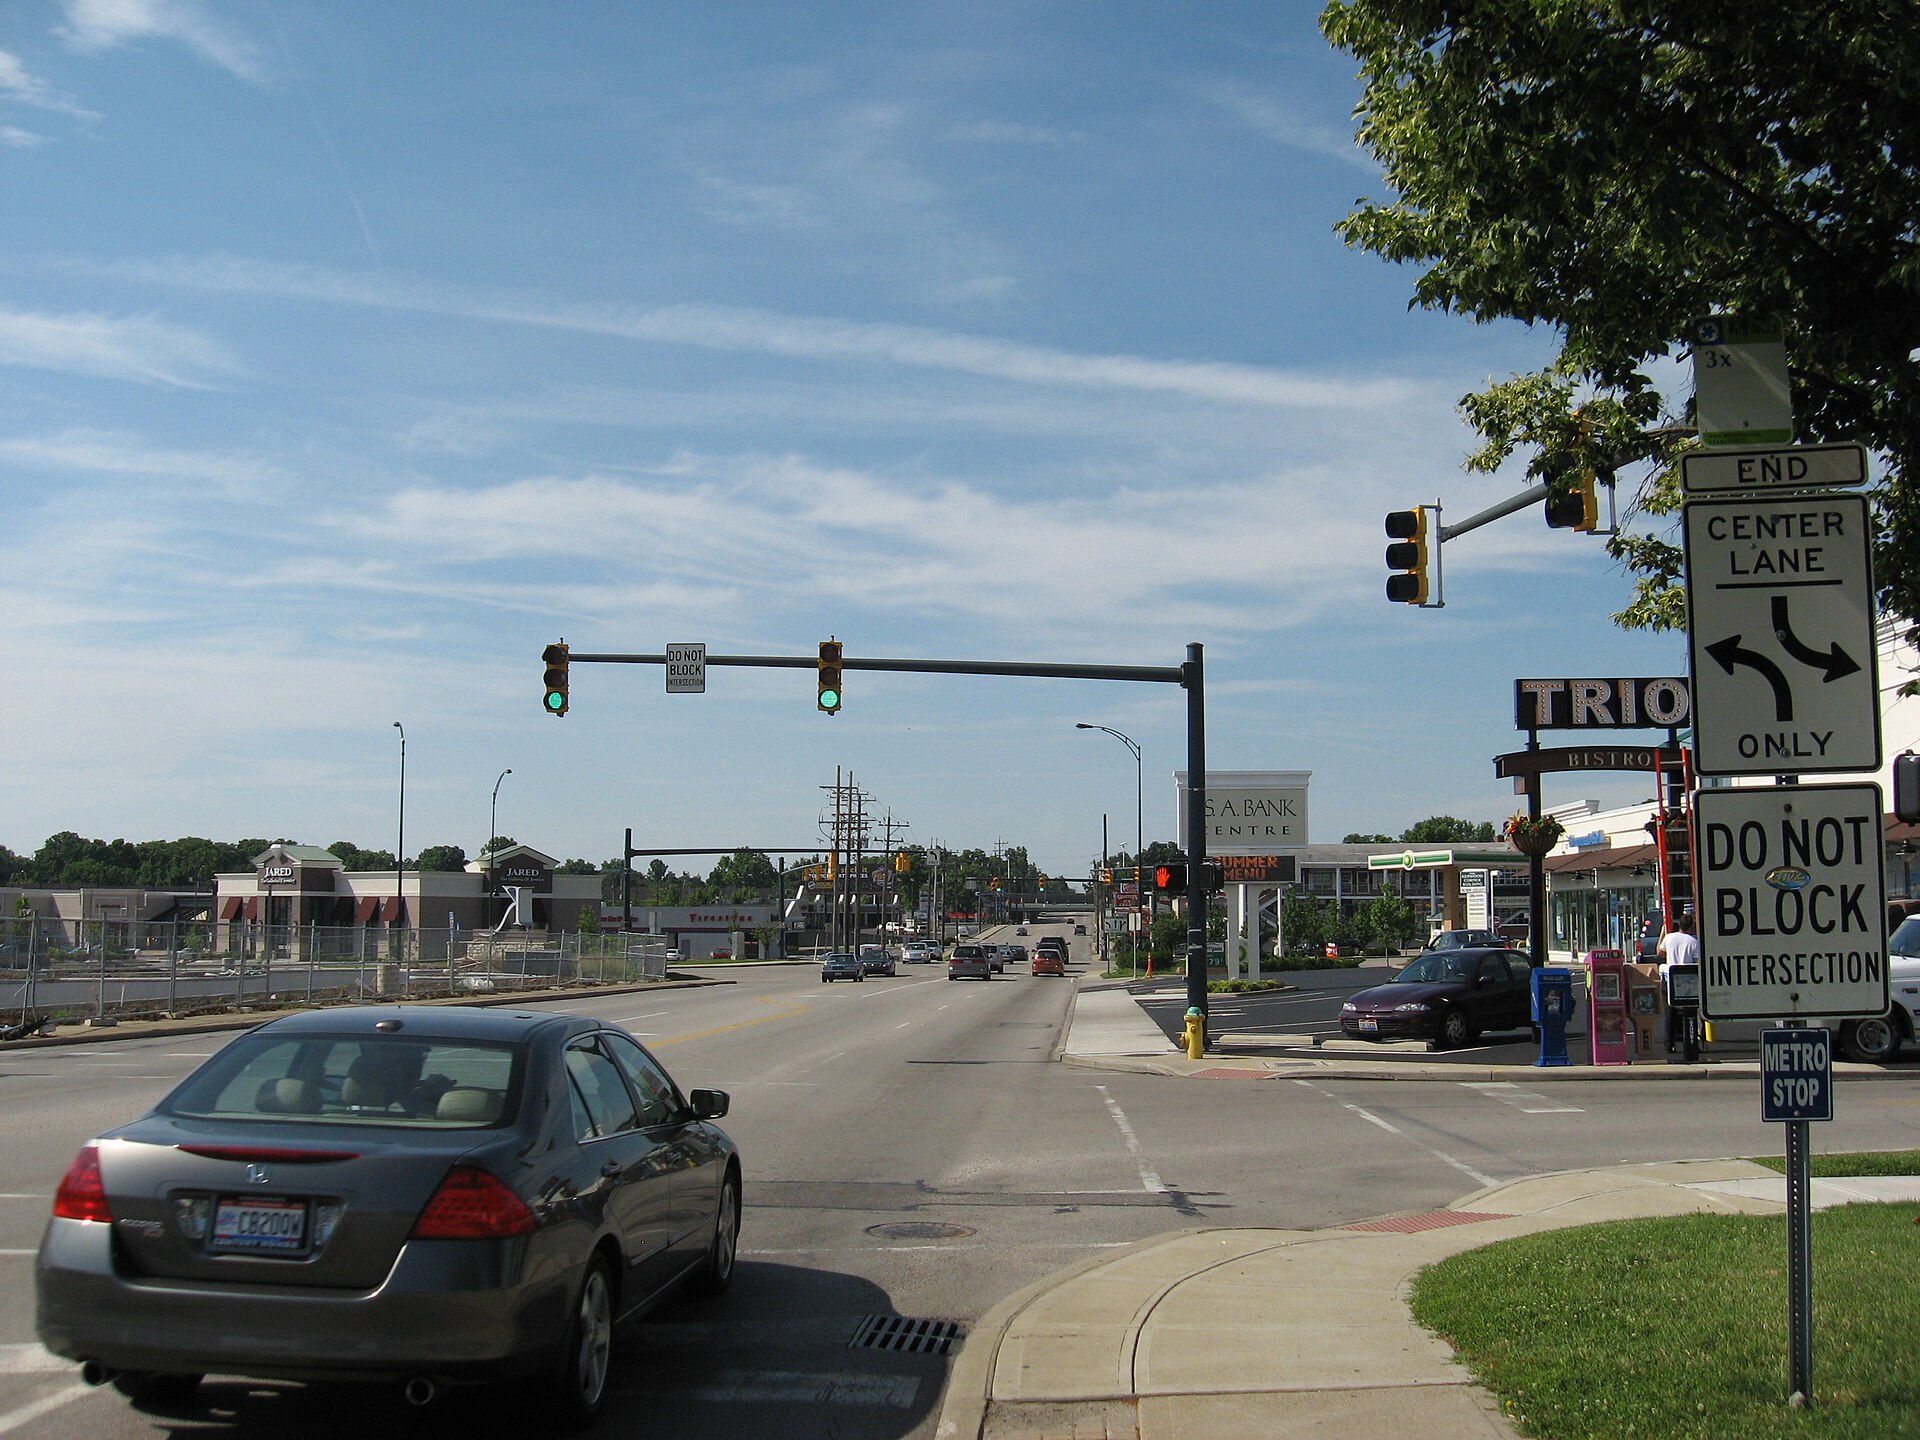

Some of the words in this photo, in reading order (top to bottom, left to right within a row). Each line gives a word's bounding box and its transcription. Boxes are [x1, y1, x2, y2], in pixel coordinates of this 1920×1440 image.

[1704, 350, 1732, 369] 3x
[1737, 456, 1808, 484] END
[1707, 511, 1844, 541] CENTER
[1730, 547, 1825, 576] LANE
[669, 650, 682, 662] DO
[684, 649, 703, 662] NOT
[670, 664, 702, 676] BLOCK
[1521, 678, 1690, 725] TRIO
[1738, 730, 1834, 759] ONLY
[1568, 751, 1651, 767] BISTRO
[1243, 798, 1298, 817] BANK
[1706, 820, 1768, 872] DO
[1781, 816, 1870, 868] NOT
[264, 867, 292, 878] JARED
[506, 868, 539, 877] JARED
[1223, 867, 1266, 880] MENU
[1716, 883, 1869, 937] BLOCK
[1708, 951, 1880, 987] INTERSECTION
[1764, 1042, 1827, 1073] METRO
[1772, 1077, 1820, 1108] STOP
